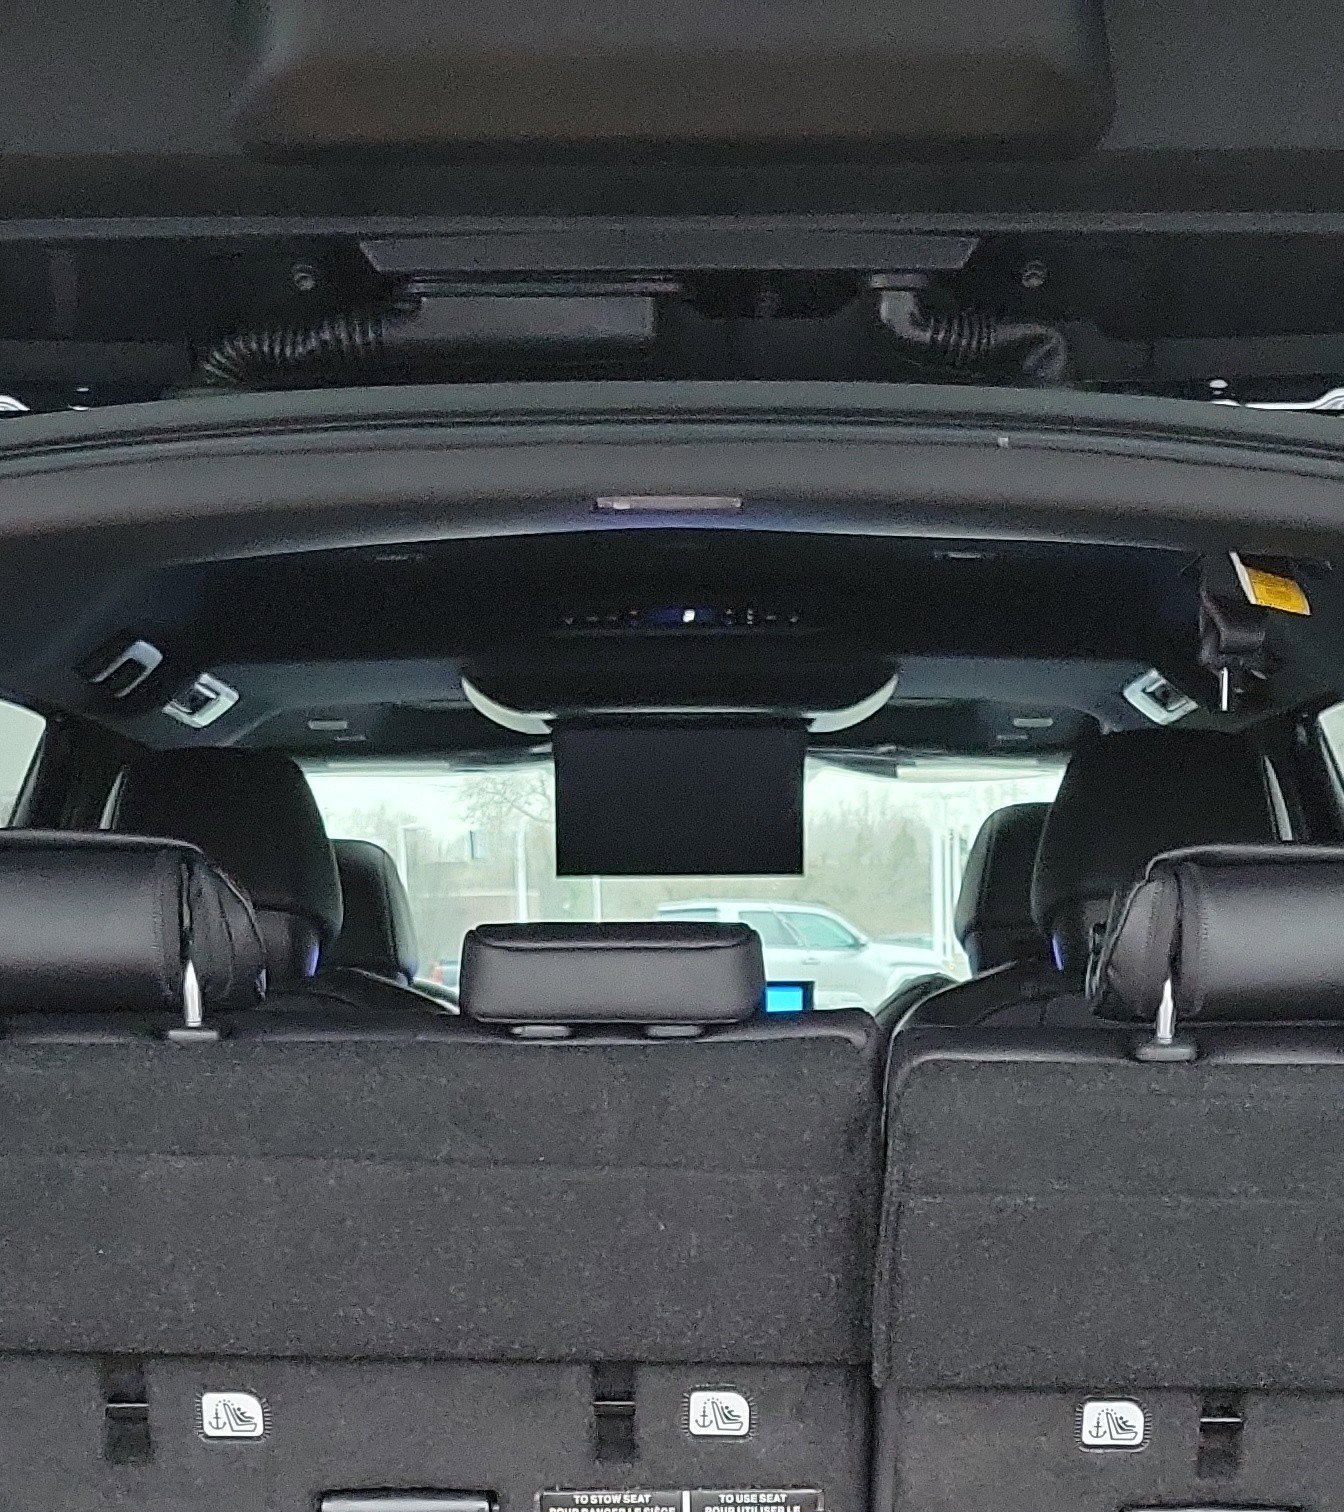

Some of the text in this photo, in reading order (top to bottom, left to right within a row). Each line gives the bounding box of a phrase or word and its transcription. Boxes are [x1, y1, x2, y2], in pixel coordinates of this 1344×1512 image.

[573, 1494, 651, 1504] TO STOW SEAT
[718, 1493, 787, 1503] TO USE SEAT
